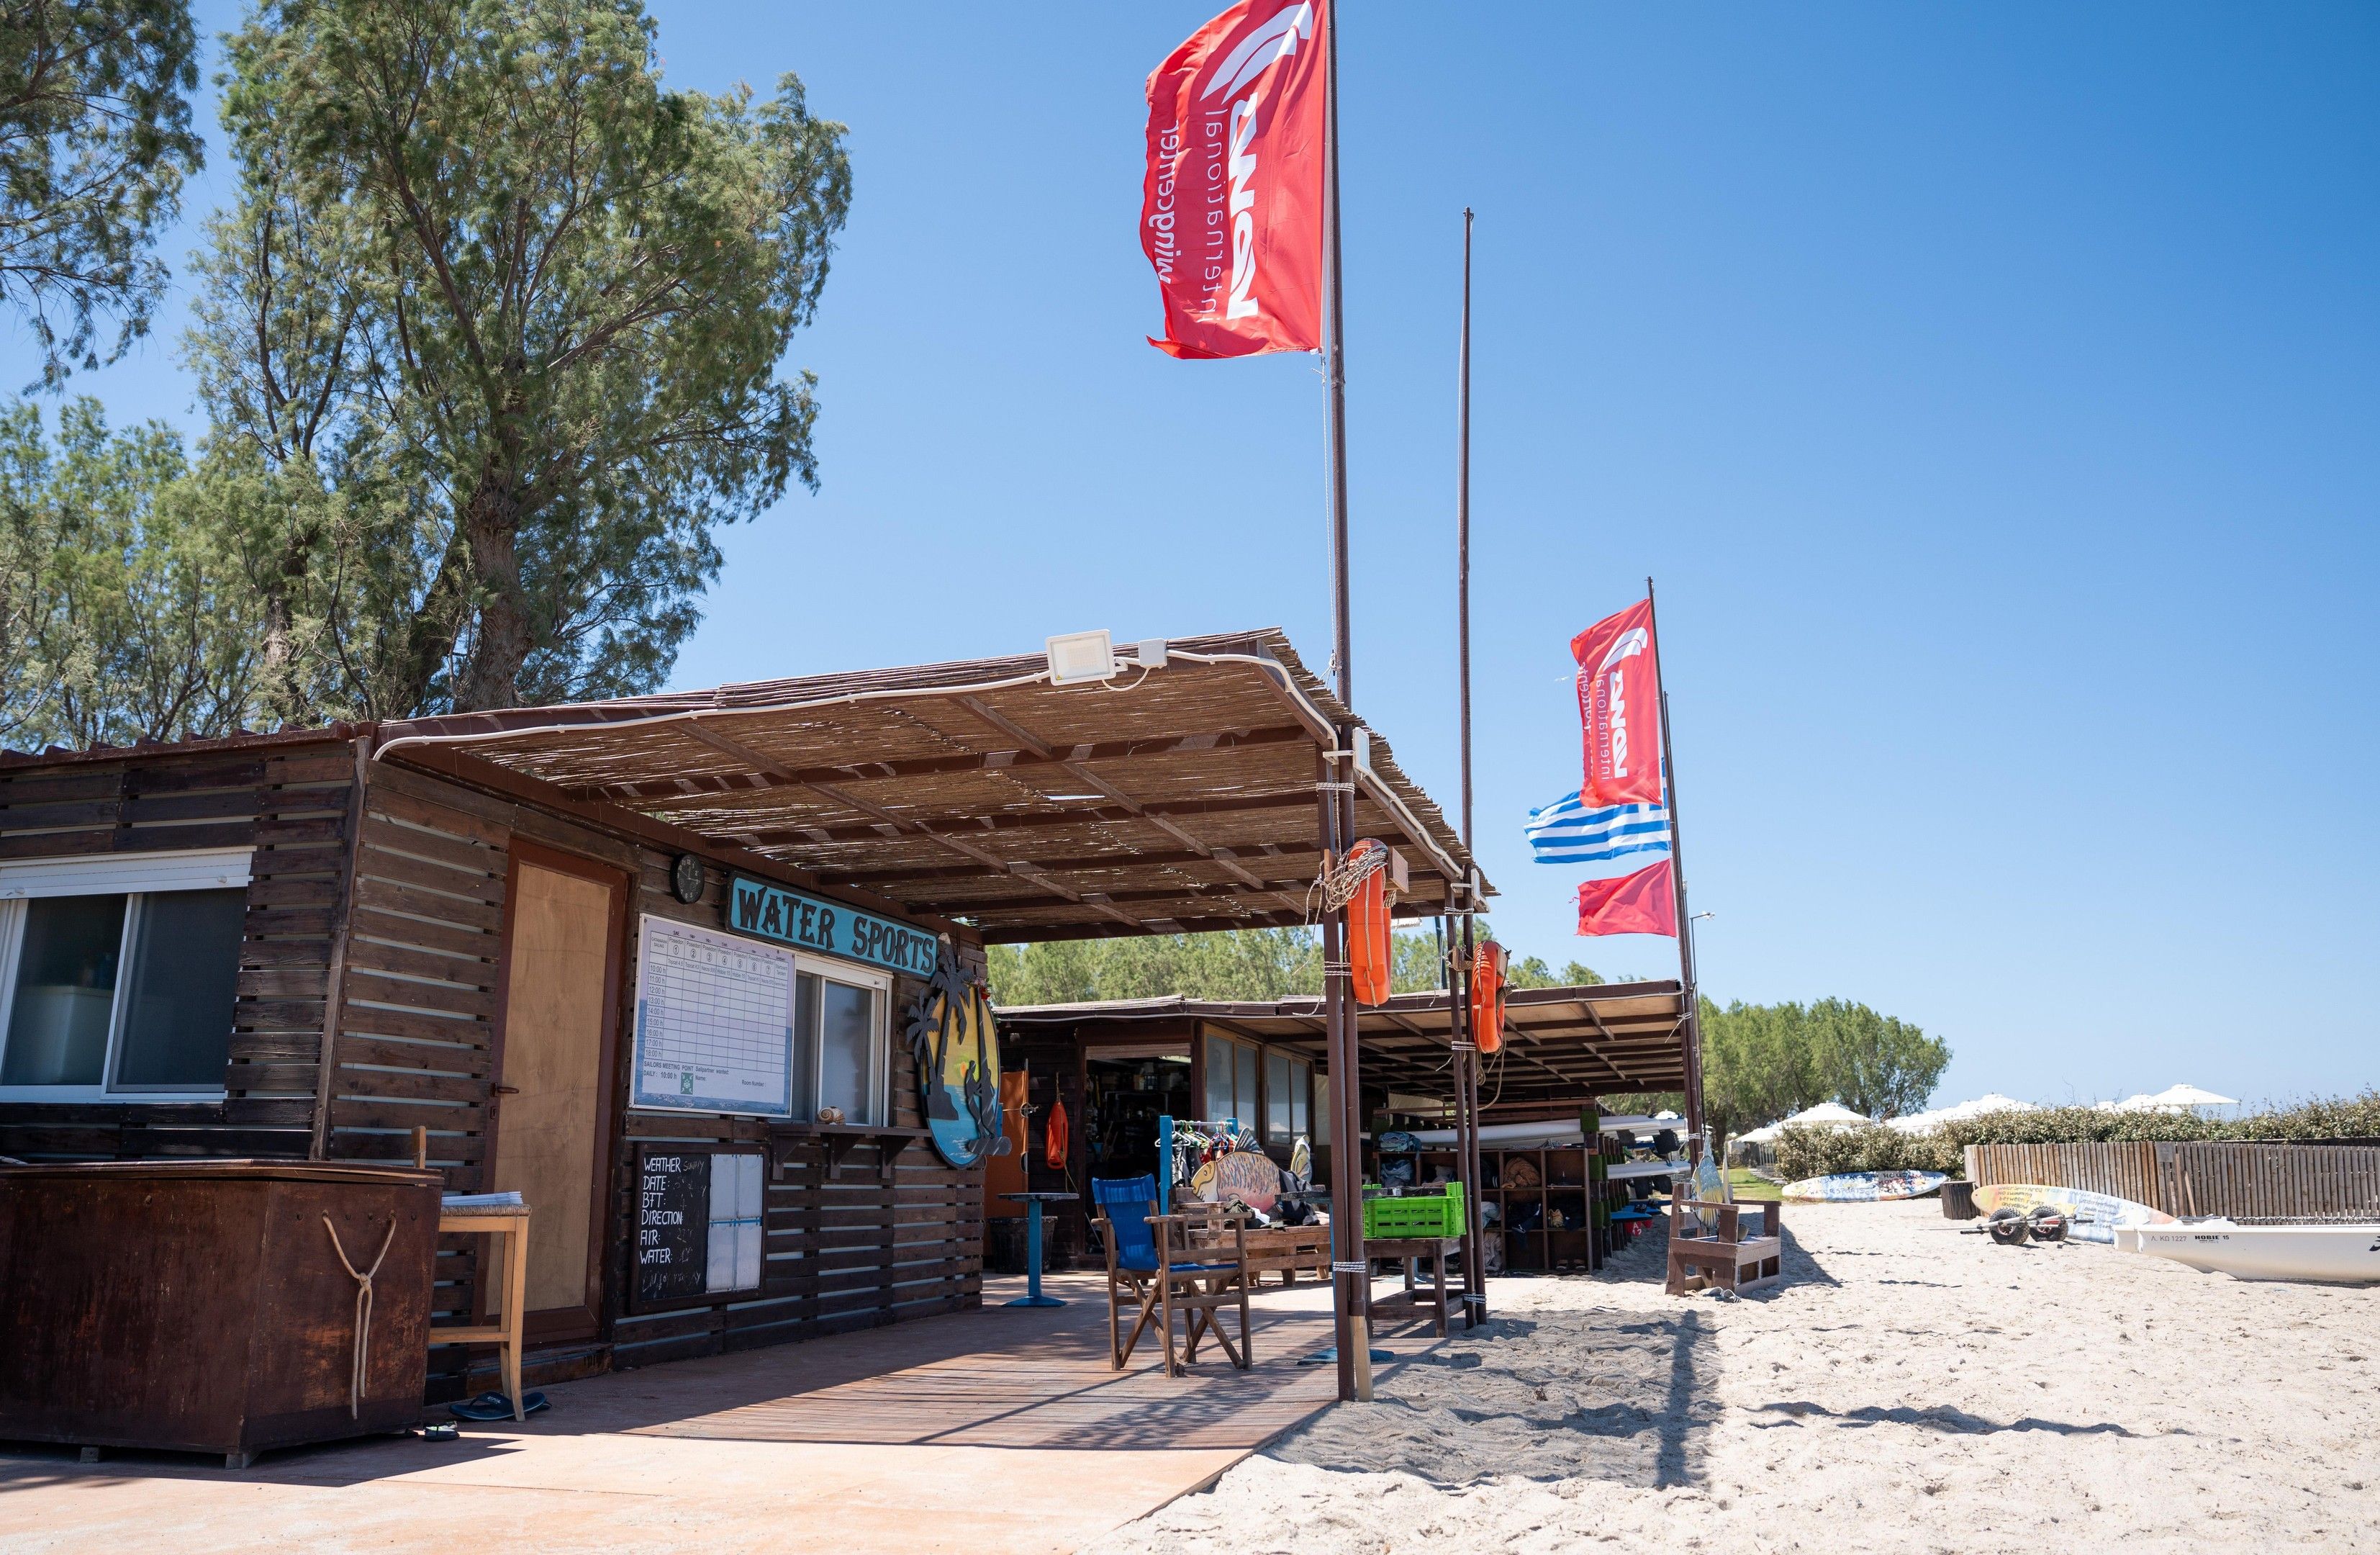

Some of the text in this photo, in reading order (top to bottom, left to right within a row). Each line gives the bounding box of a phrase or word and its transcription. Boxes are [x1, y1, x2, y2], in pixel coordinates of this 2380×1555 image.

[738, 886, 935, 974] WATER SPORTS
[643, 1157, 682, 1173] WEATHER
[640, 1229, 661, 1246] AIR:
[639, 1248, 673, 1264] WATER:
